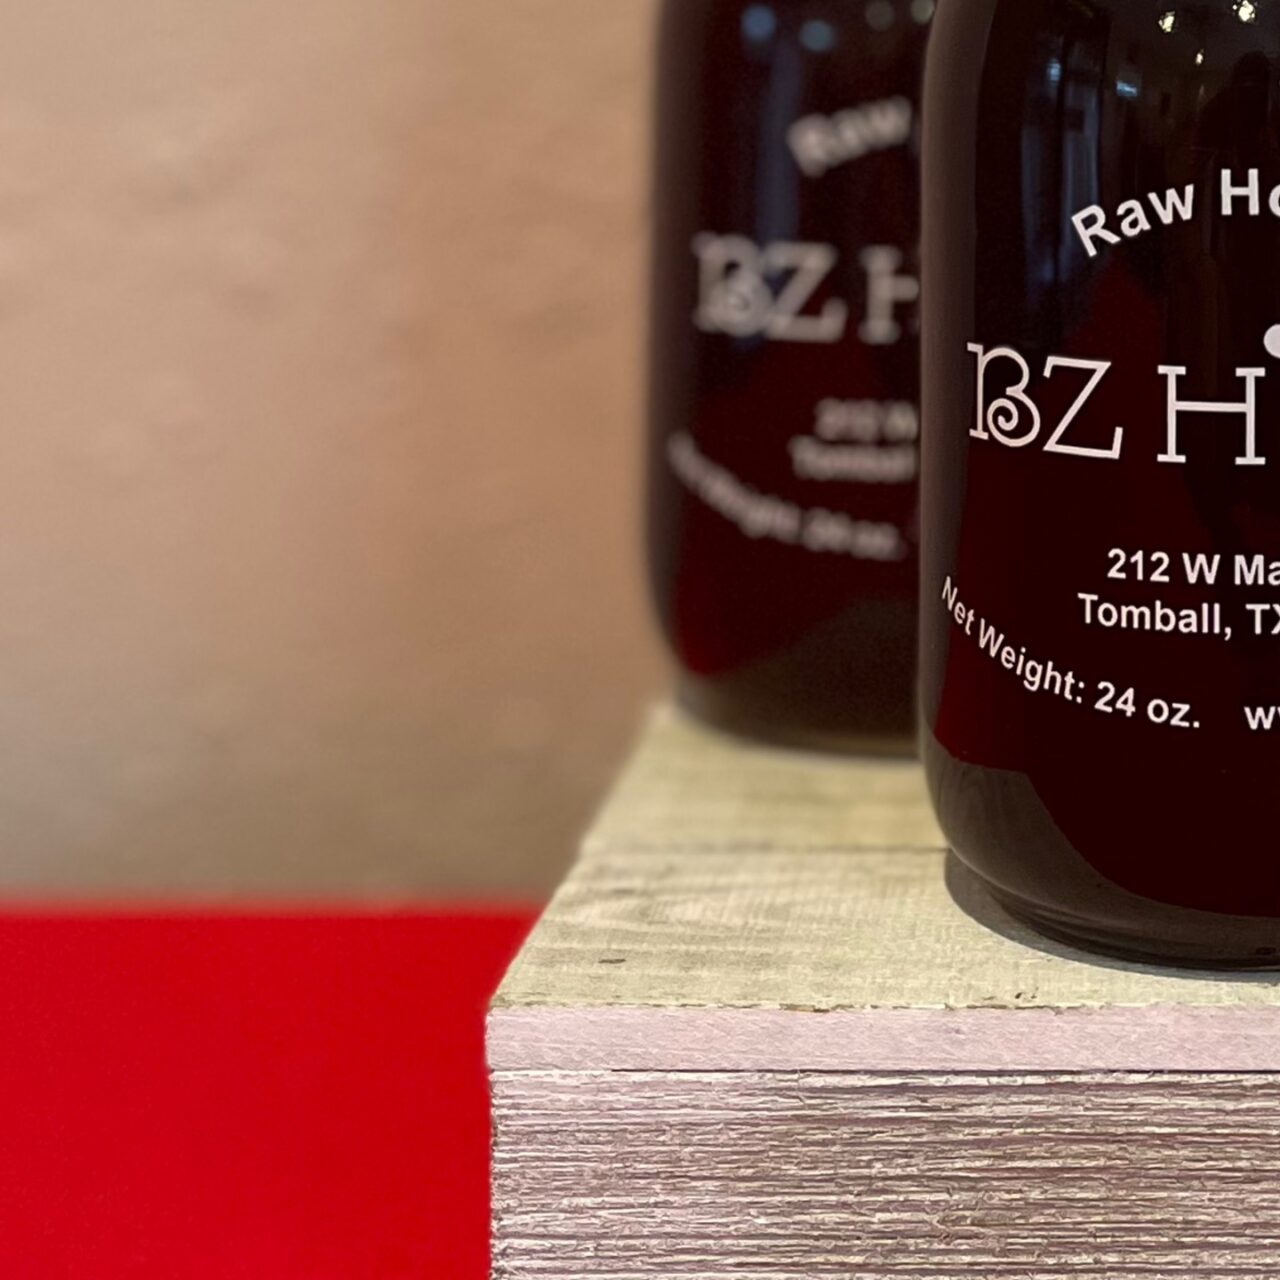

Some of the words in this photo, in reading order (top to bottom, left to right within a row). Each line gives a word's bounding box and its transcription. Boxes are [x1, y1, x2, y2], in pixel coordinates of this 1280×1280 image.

[1070, 183, 1194, 258] Raw
[691, 232, 848, 344] BZ
[967, 342, 1124, 460] BZ
[1107, 548, 1170, 583] 212
[1181, 552, 1221, 585] W
[941, 575, 975, 636] Net
[979, 618, 1085, 704] Weight:
[1094, 681, 1136, 717] 24
[1147, 698, 1200, 728] oz.
[1077, 592, 1232, 641] Tomball,
